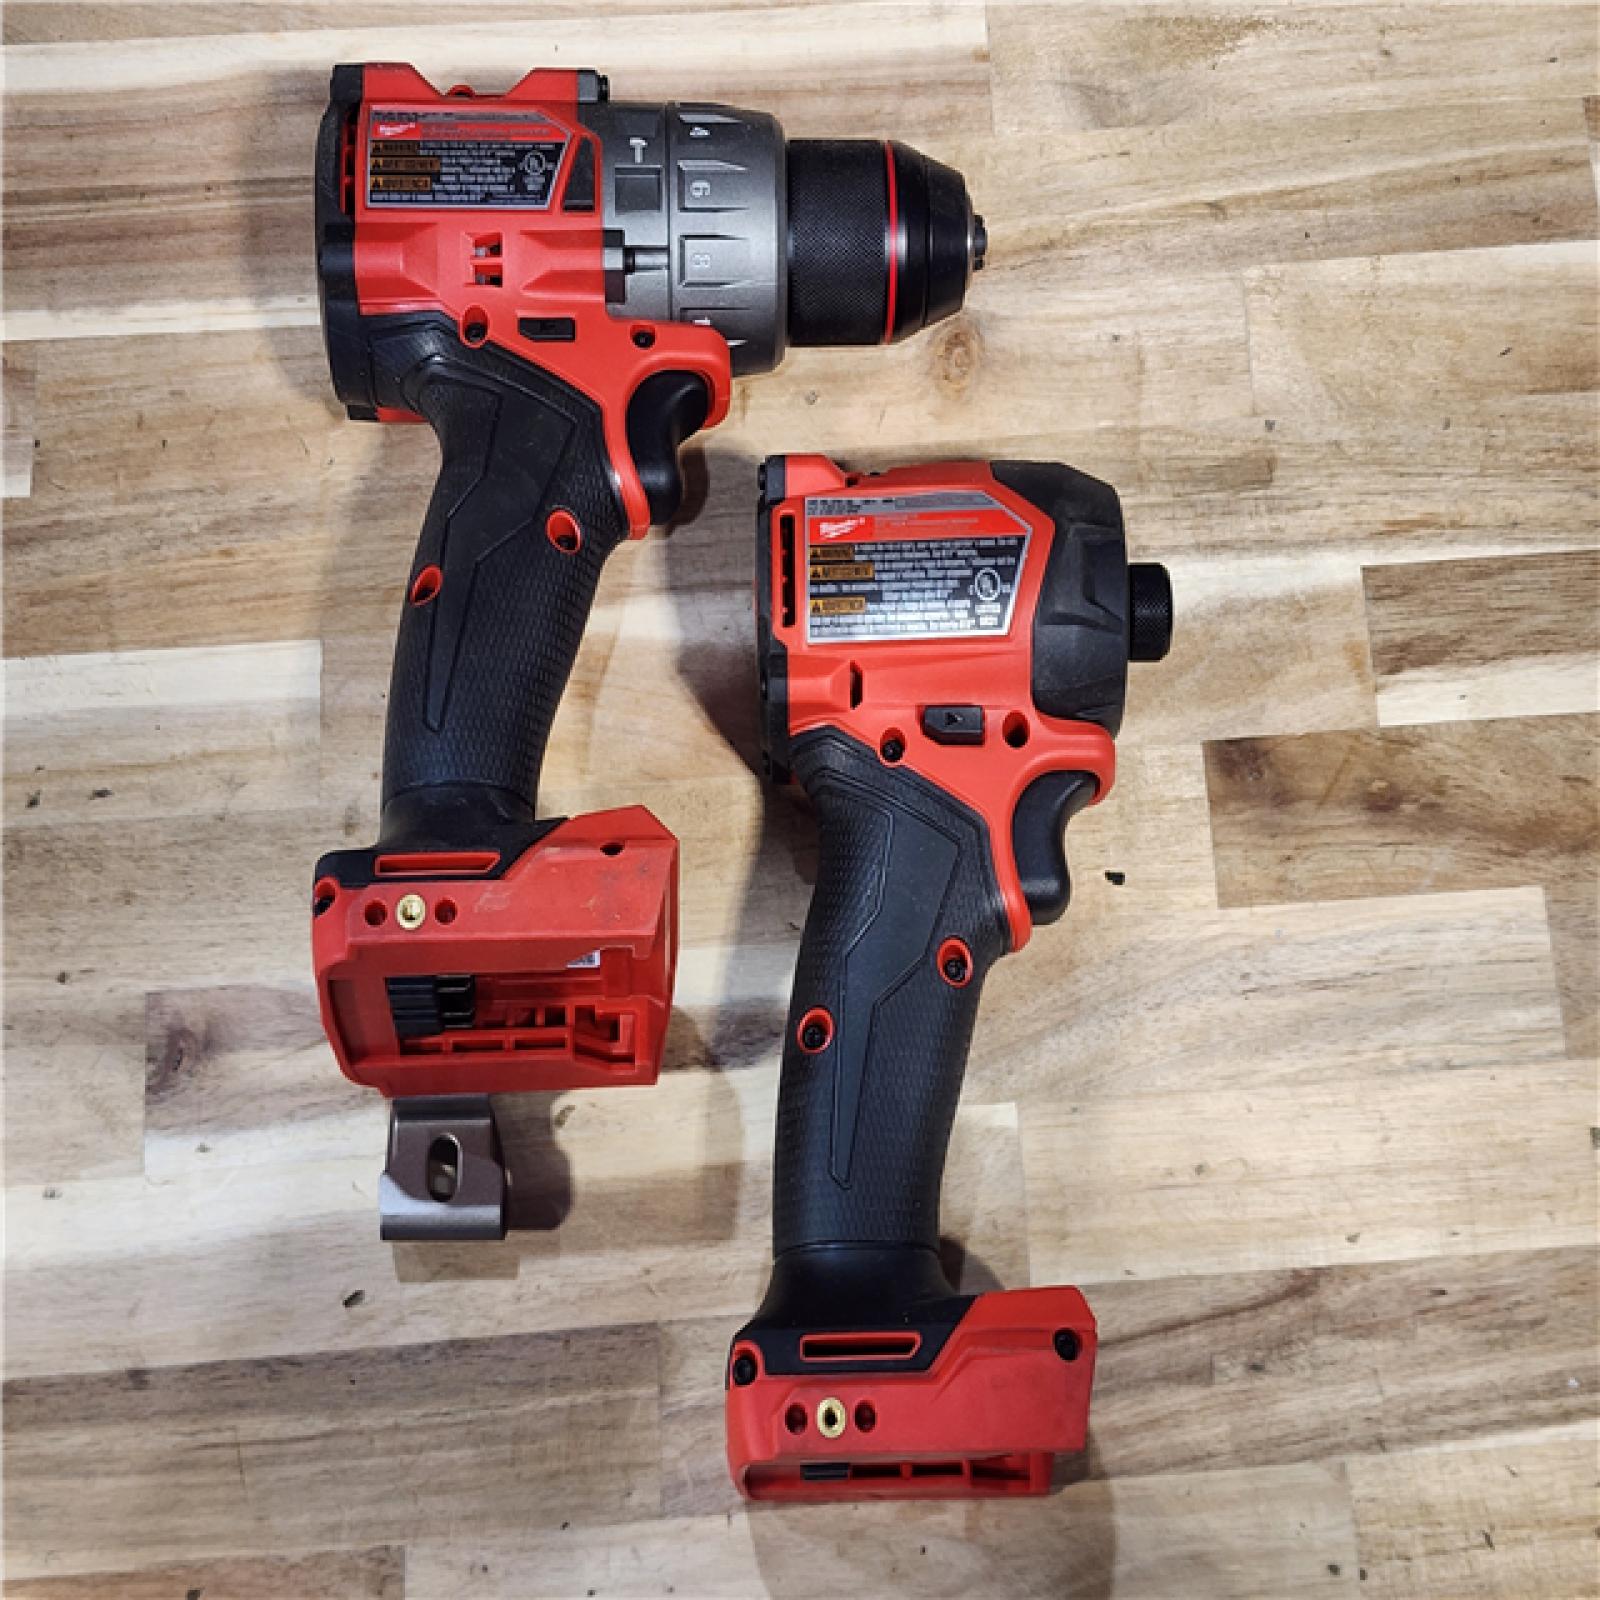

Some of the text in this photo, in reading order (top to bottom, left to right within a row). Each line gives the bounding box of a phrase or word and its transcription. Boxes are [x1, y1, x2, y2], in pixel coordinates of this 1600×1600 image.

[689, 126, 711, 137] 4
[690, 179, 711, 198] 6
[692, 253, 711, 270] 8
[692, 316, 711, 326] 1
